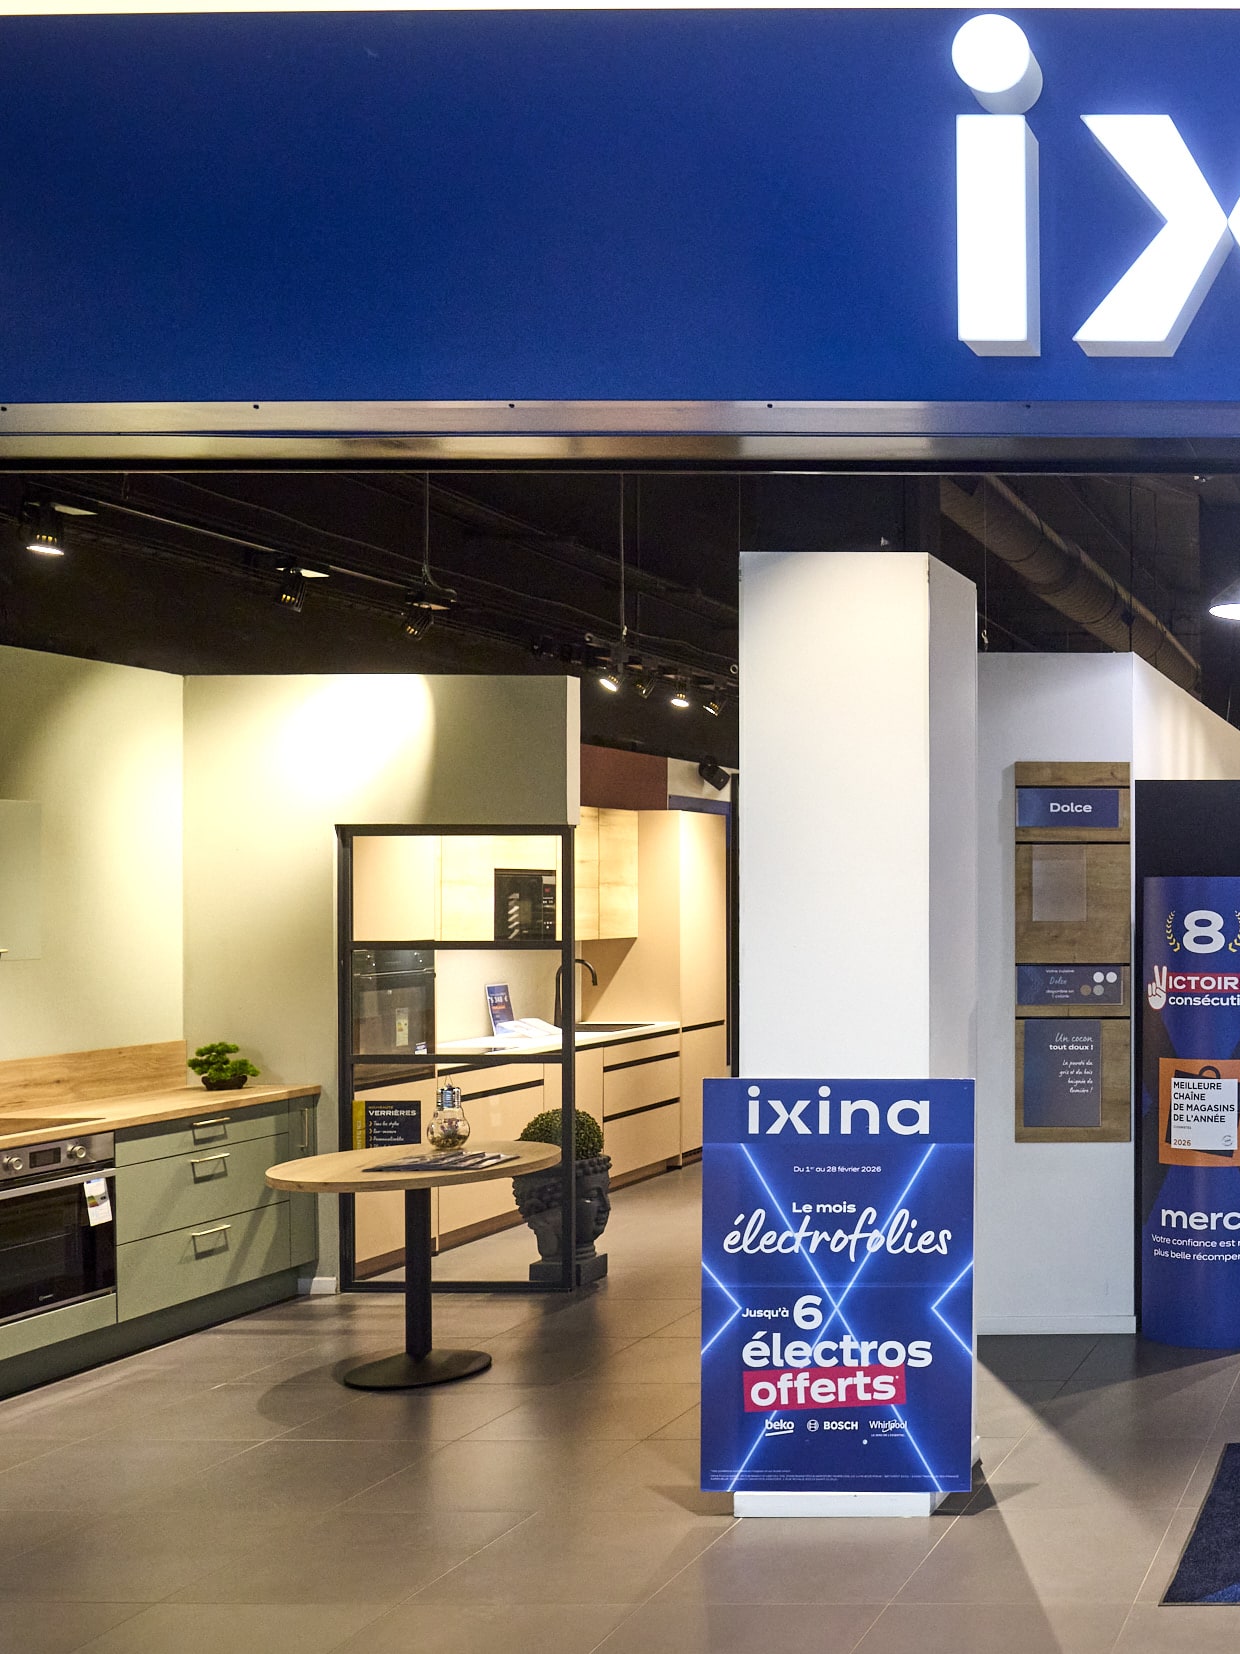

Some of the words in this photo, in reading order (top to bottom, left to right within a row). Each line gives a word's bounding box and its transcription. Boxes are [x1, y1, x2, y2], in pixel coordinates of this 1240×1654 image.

[1049, 802, 1093, 813] Dolce
[1182, 910, 1226, 953] 8
[1055, 1032, 1068, 1042] Un
[1173, 1081, 1222, 1090] MEILLEURE
[1173, 1091, 1206, 1101] CHAÎNE
[748, 1085, 930, 1135] ixina
[1173, 1103, 1184, 1111] DE
[1186, 1104, 1235, 1112] MAGASINS
[1173, 1114, 1184, 1122] DE
[1186, 1114, 1226, 1122] L'ANNÉE
[792, 1202, 813, 1213] Le
[816, 1201, 856, 1213] mois
[723, 1207, 952, 1262] électrofolies
[1151, 1234, 1171, 1244] Votre
[1172, 1238, 1217, 1247] confiance
[1219, 1239, 1236, 1247] est
[1153, 1248, 1169, 1258] plus
[1170, 1250, 1191, 1259] belle
[742, 1308, 789, 1320] Jusqu'à
[793, 1294, 823, 1330] 6
[742, 1331, 933, 1368] électros
[765, 1419, 795, 1430] beko
[823, 1421, 859, 1430] BOSCH
[869, 1420, 907, 1432] Whirlpool
